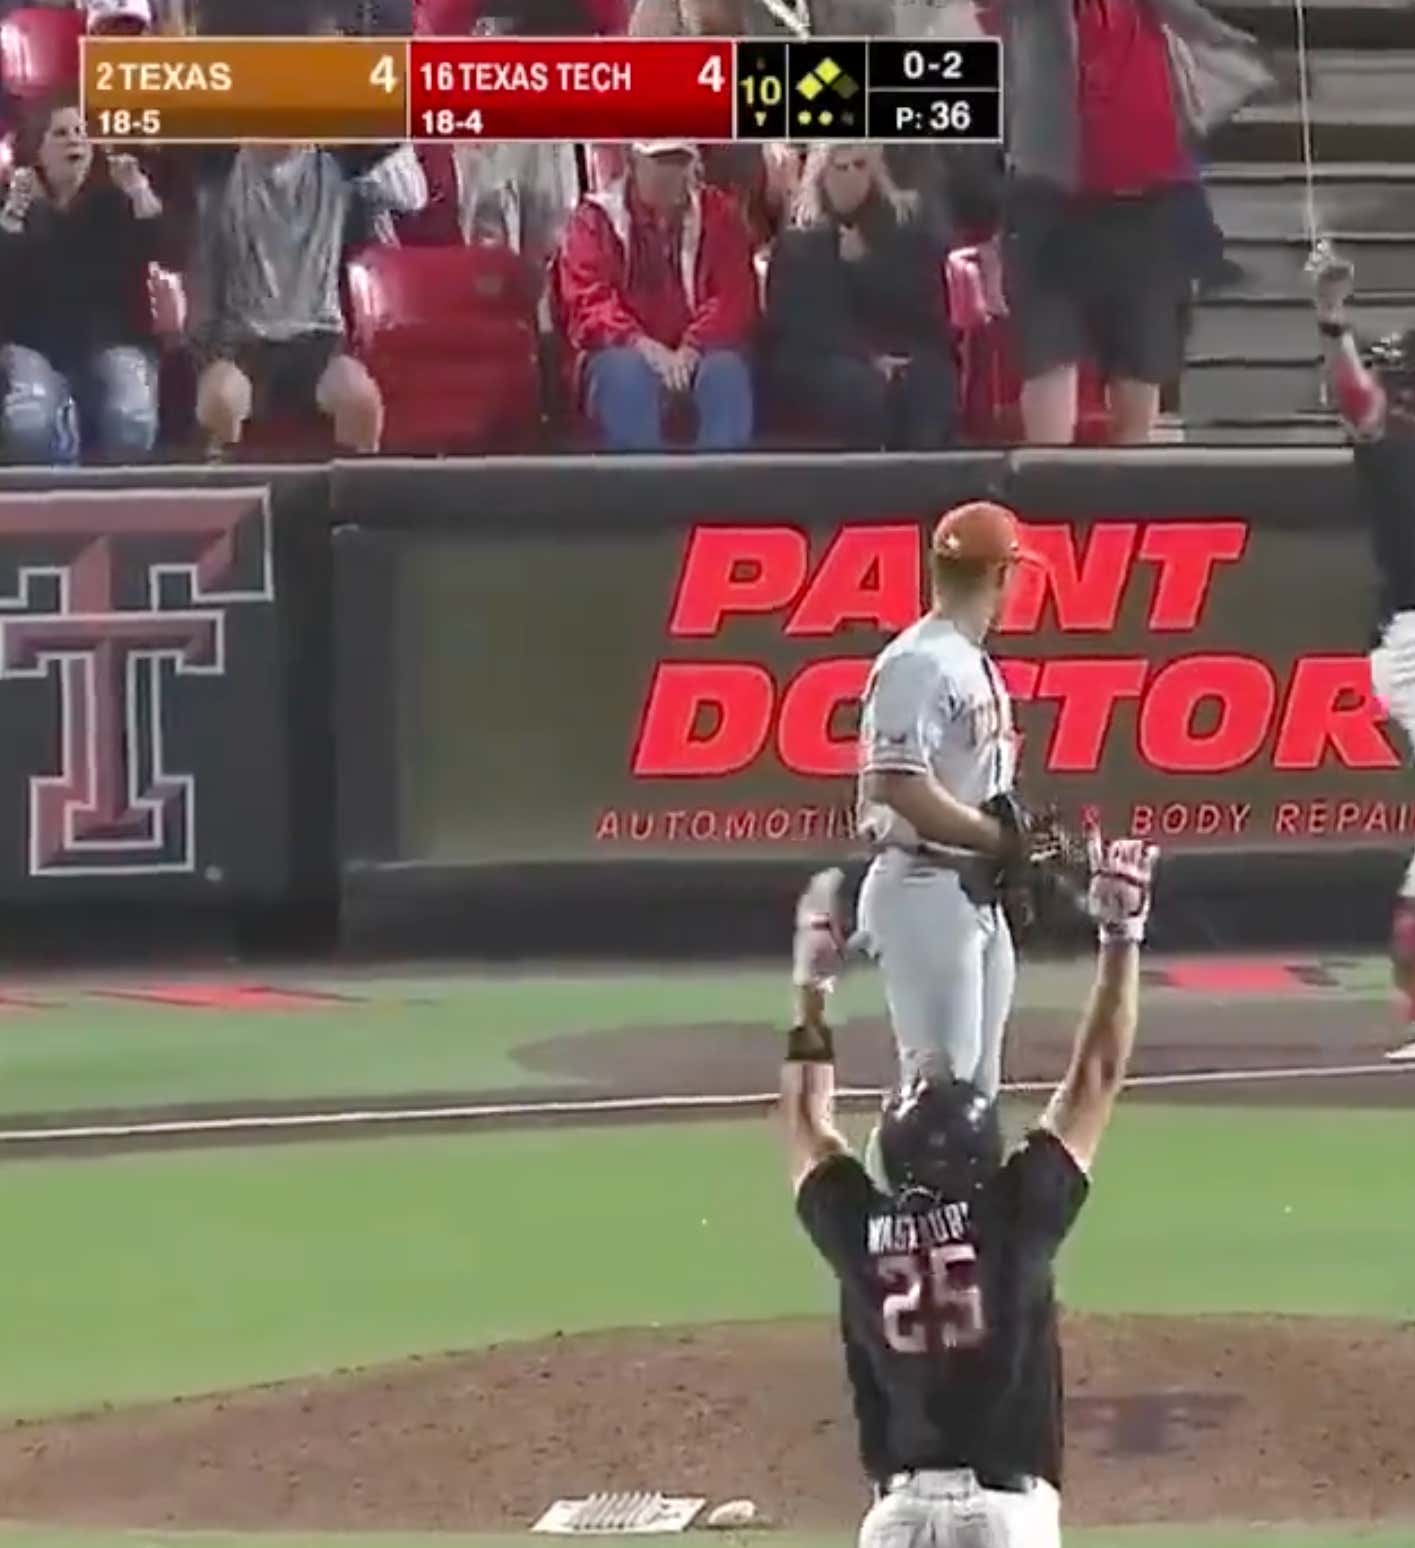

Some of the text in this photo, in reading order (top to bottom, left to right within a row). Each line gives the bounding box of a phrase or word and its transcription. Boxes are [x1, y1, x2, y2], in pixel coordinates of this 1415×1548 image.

[669, 520, 1249, 635] PANT
[632, 654, 1401, 775] DOTOR
[1131, 803, 1250, 835] BODY
[876, 1244, 986, 1353] 25
